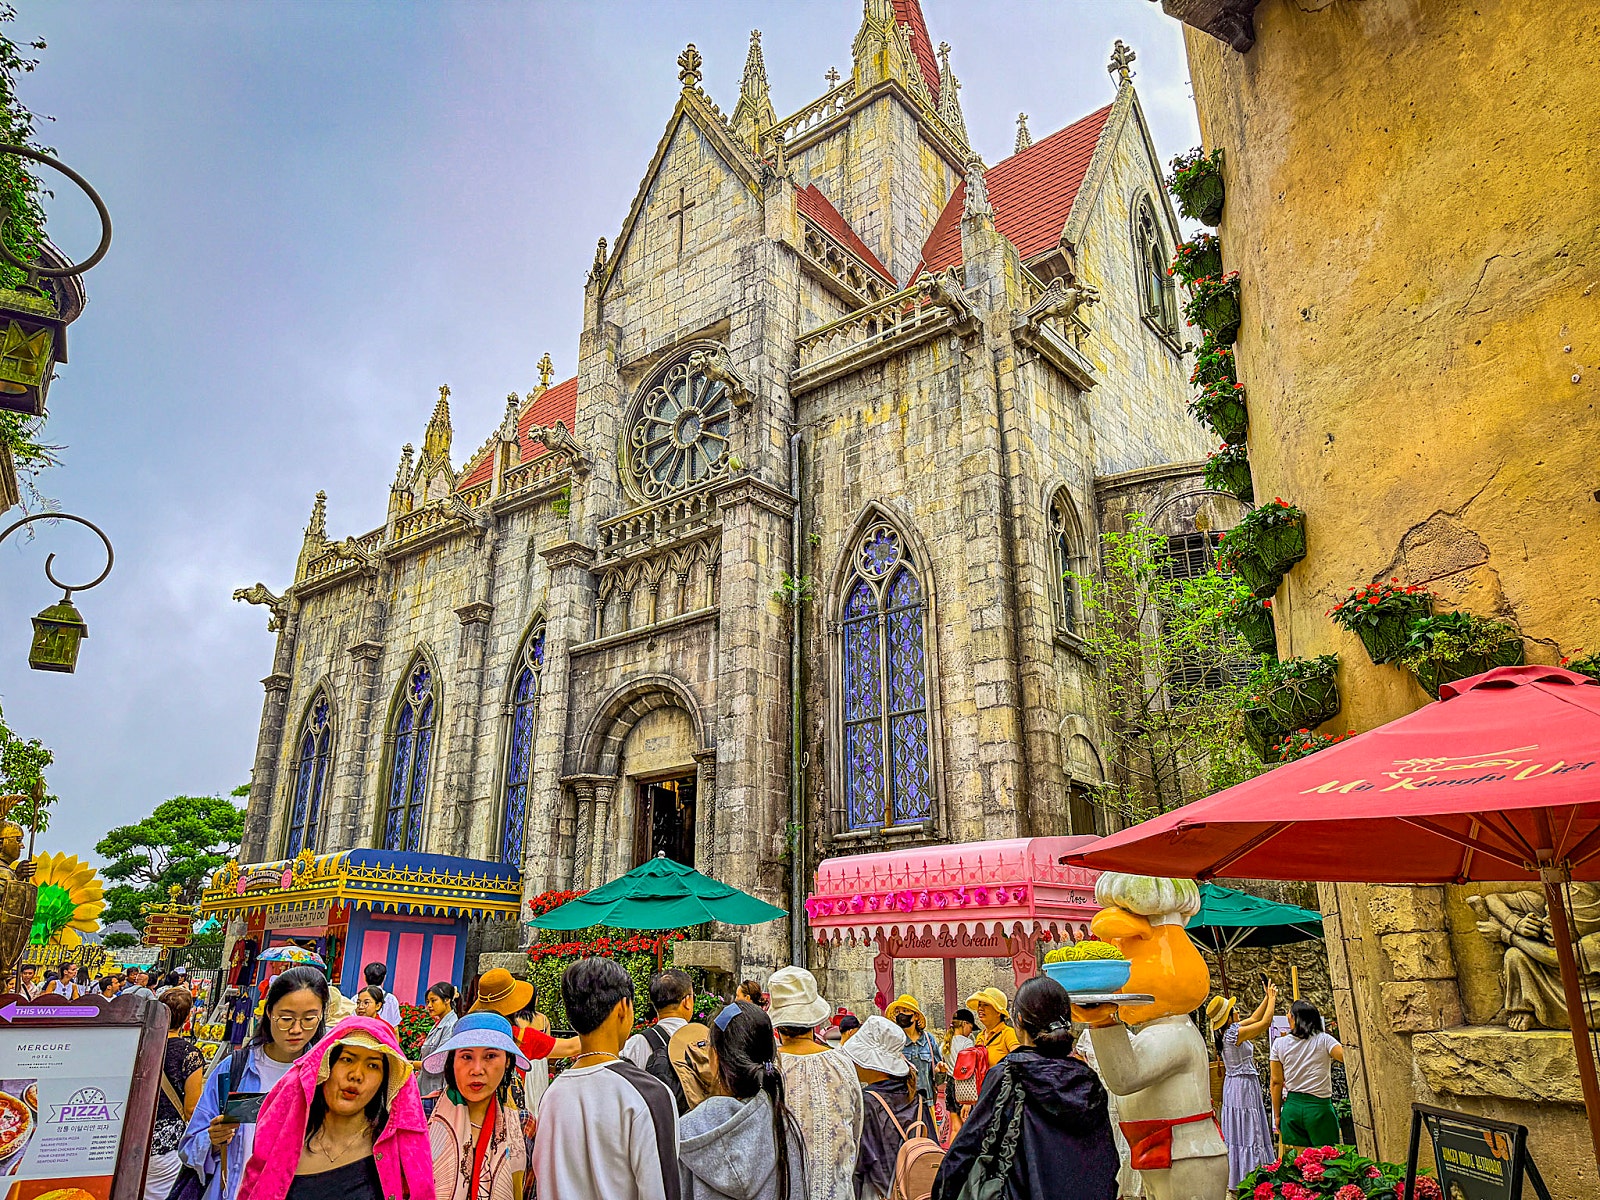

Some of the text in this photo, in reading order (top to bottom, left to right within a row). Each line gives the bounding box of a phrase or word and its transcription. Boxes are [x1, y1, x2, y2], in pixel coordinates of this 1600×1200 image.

[1379, 772, 1506, 792] Kungfu
[1066, 890, 1087, 904] Rose
[904, 931, 998, 948] Rose Ice Cream
[17, 1043, 71, 1051] MERCURE
[59, 1105, 110, 1123] PIZZA
